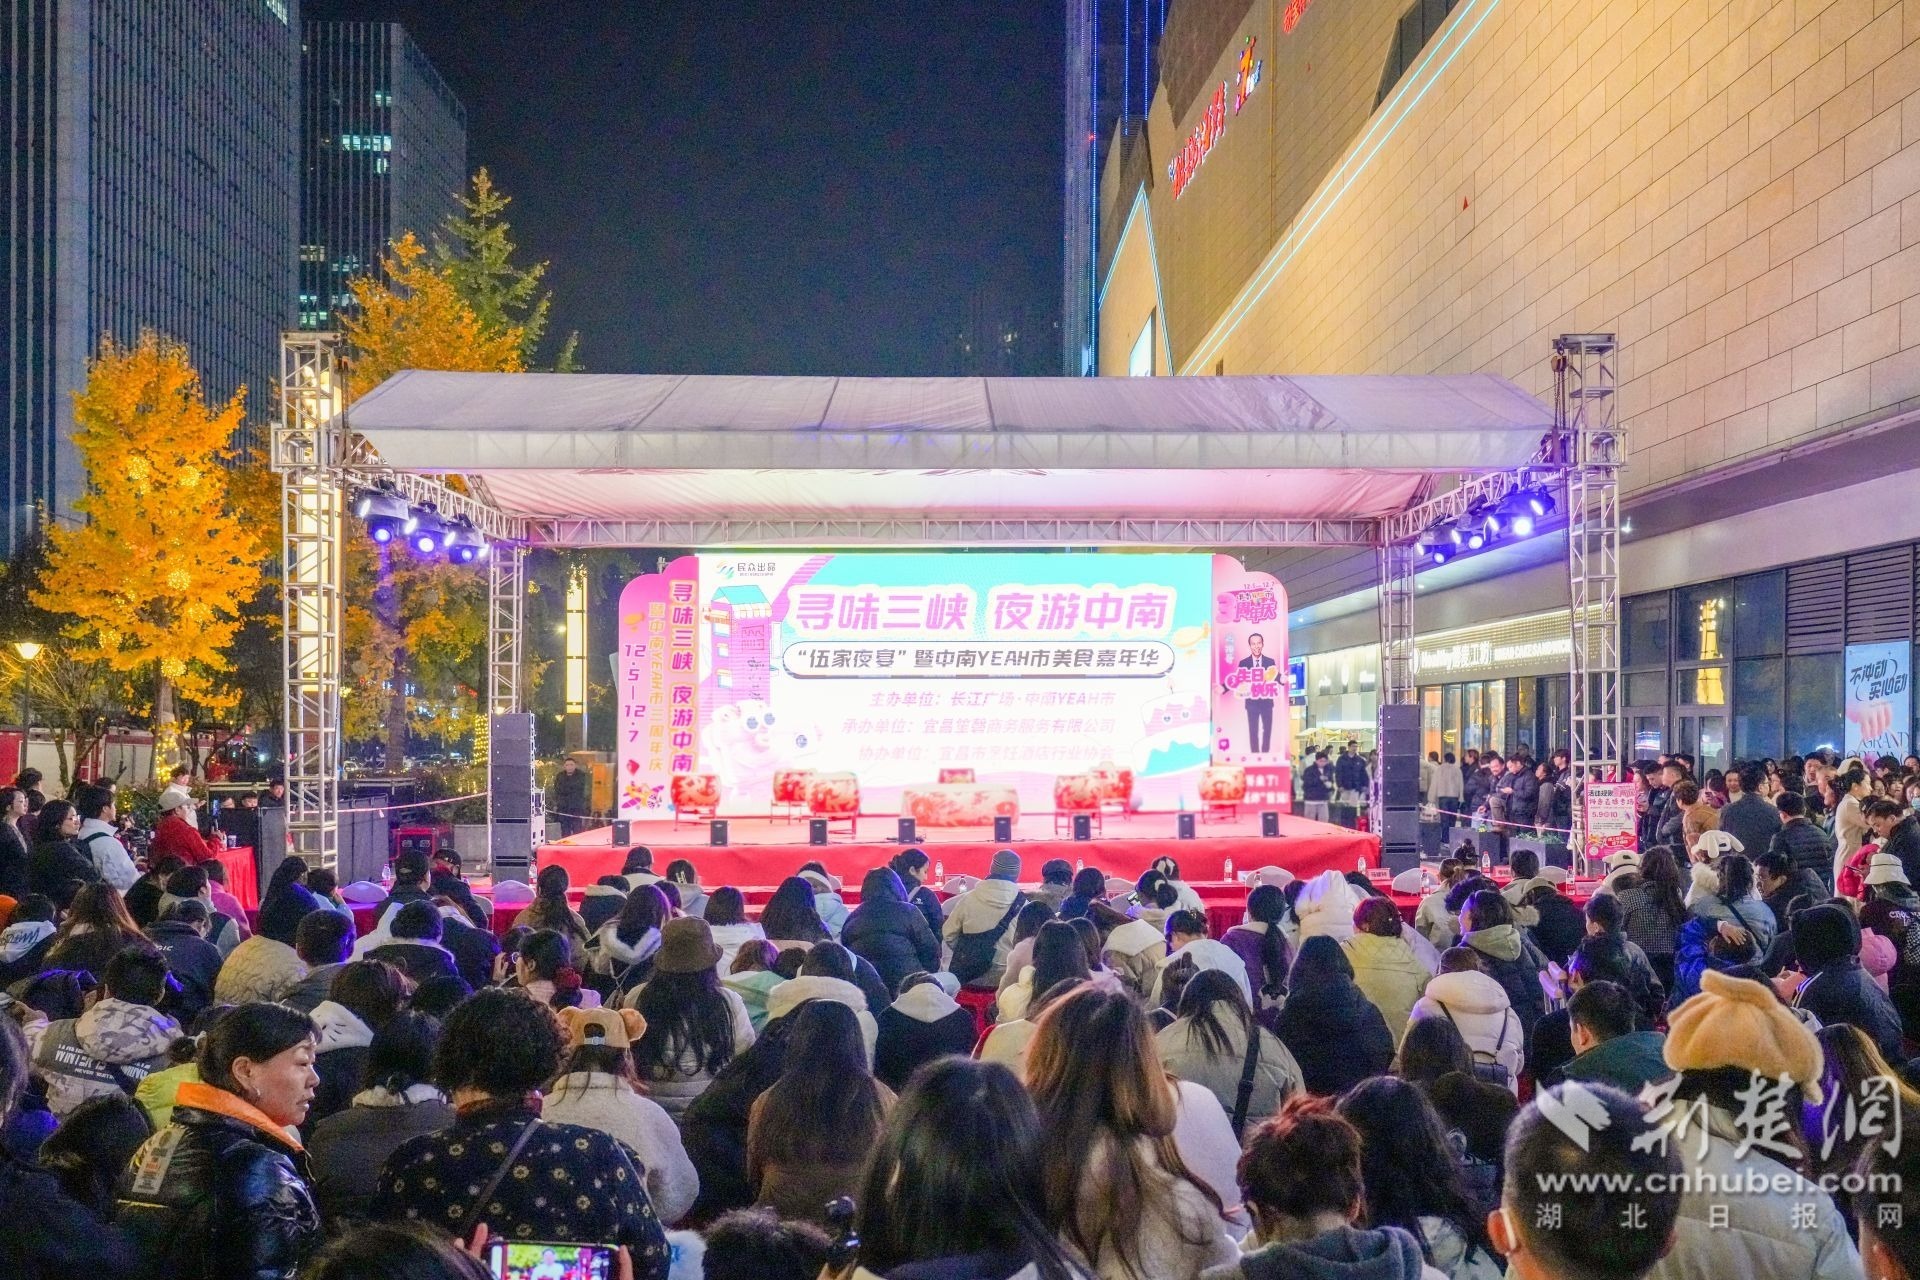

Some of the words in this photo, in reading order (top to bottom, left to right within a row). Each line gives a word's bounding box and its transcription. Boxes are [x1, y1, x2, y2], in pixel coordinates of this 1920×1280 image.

[737, 562, 776, 572] 民众出品
[796, 592, 969, 631] 寻味三峡
[994, 591, 1169, 631] 夜游中南
[672, 583, 694, 671] 寻味三峡
[1237, 668, 1264, 682] 生日
[1251, 683, 1278, 698] 快乐
[672, 685, 694, 772] 夜游中南
